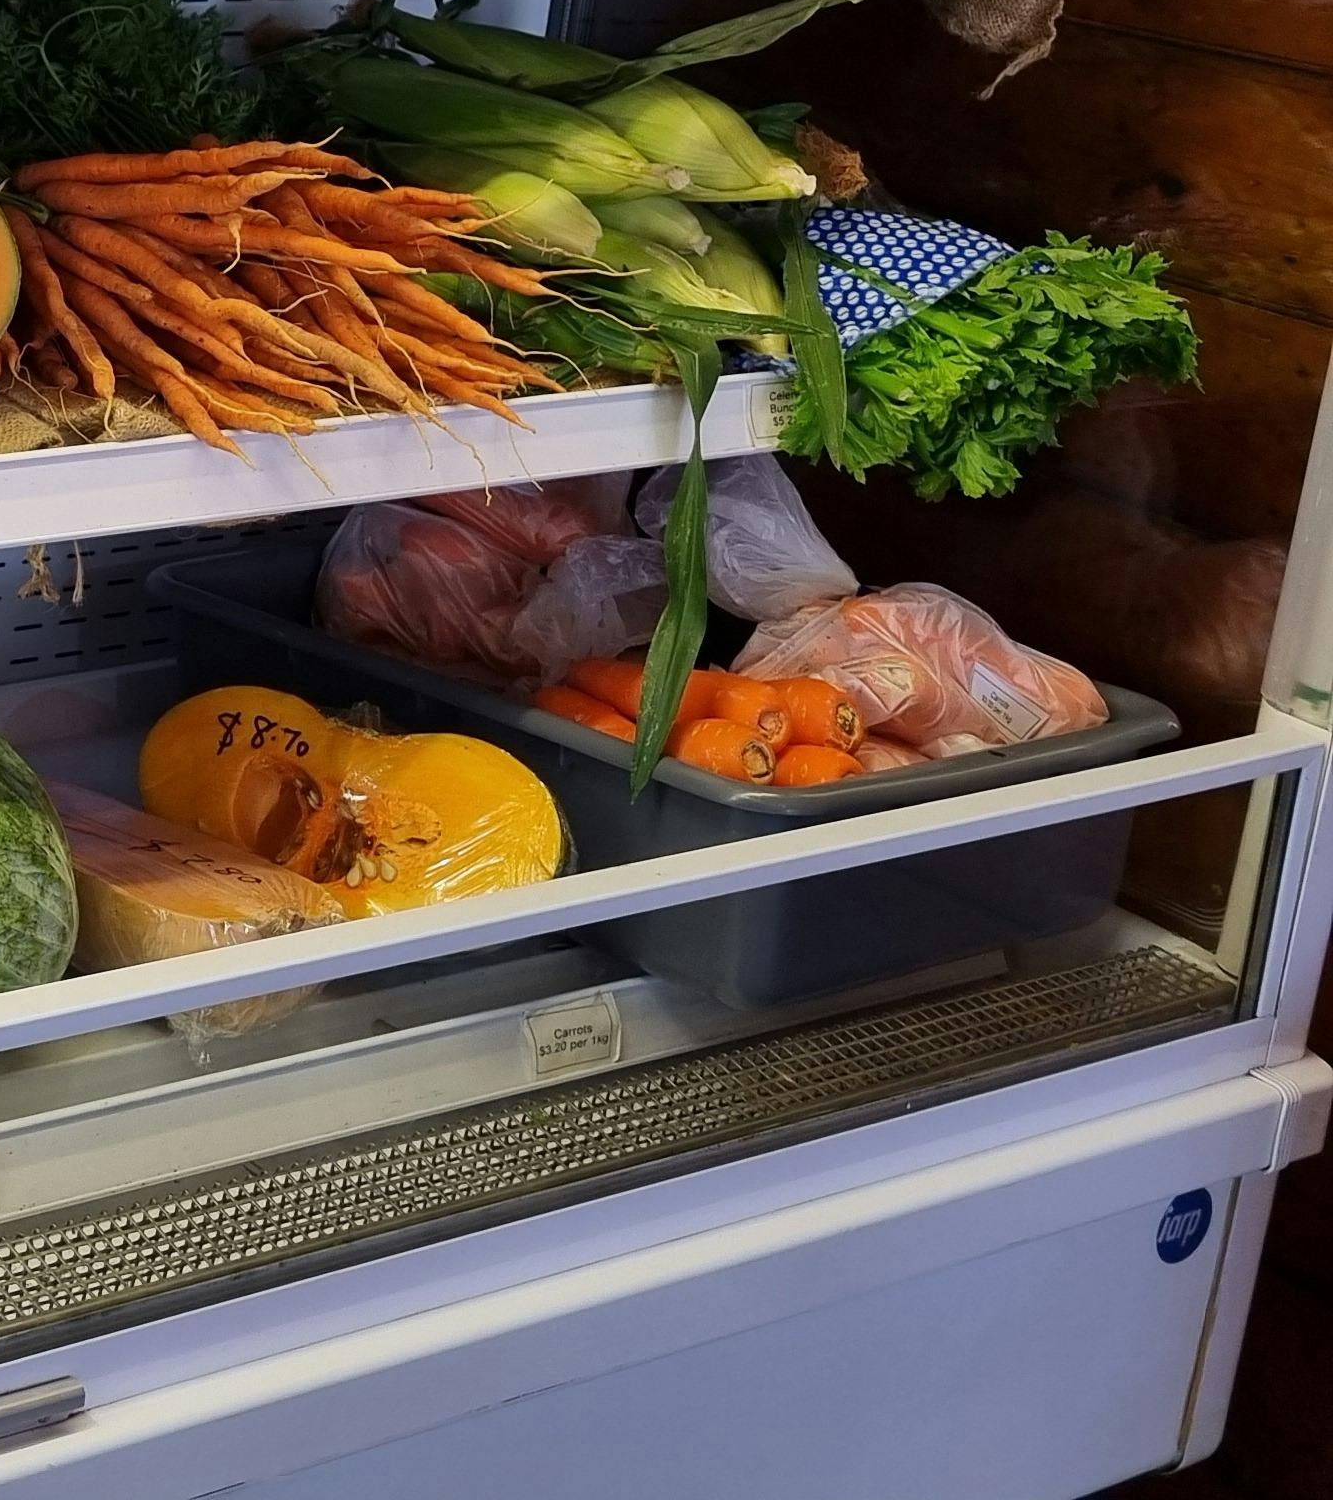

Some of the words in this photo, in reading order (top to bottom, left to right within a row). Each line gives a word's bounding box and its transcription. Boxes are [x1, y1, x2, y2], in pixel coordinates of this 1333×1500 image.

[770, 404, 796, 413] Bunc
[554, 1024, 593, 1039] Carrots
[539, 1041, 567, 1057] $3.20
[570, 1039, 587, 1052] per
[592, 1035, 609, 1045] 1kg
[1157, 1206, 1202, 1247] iarp
